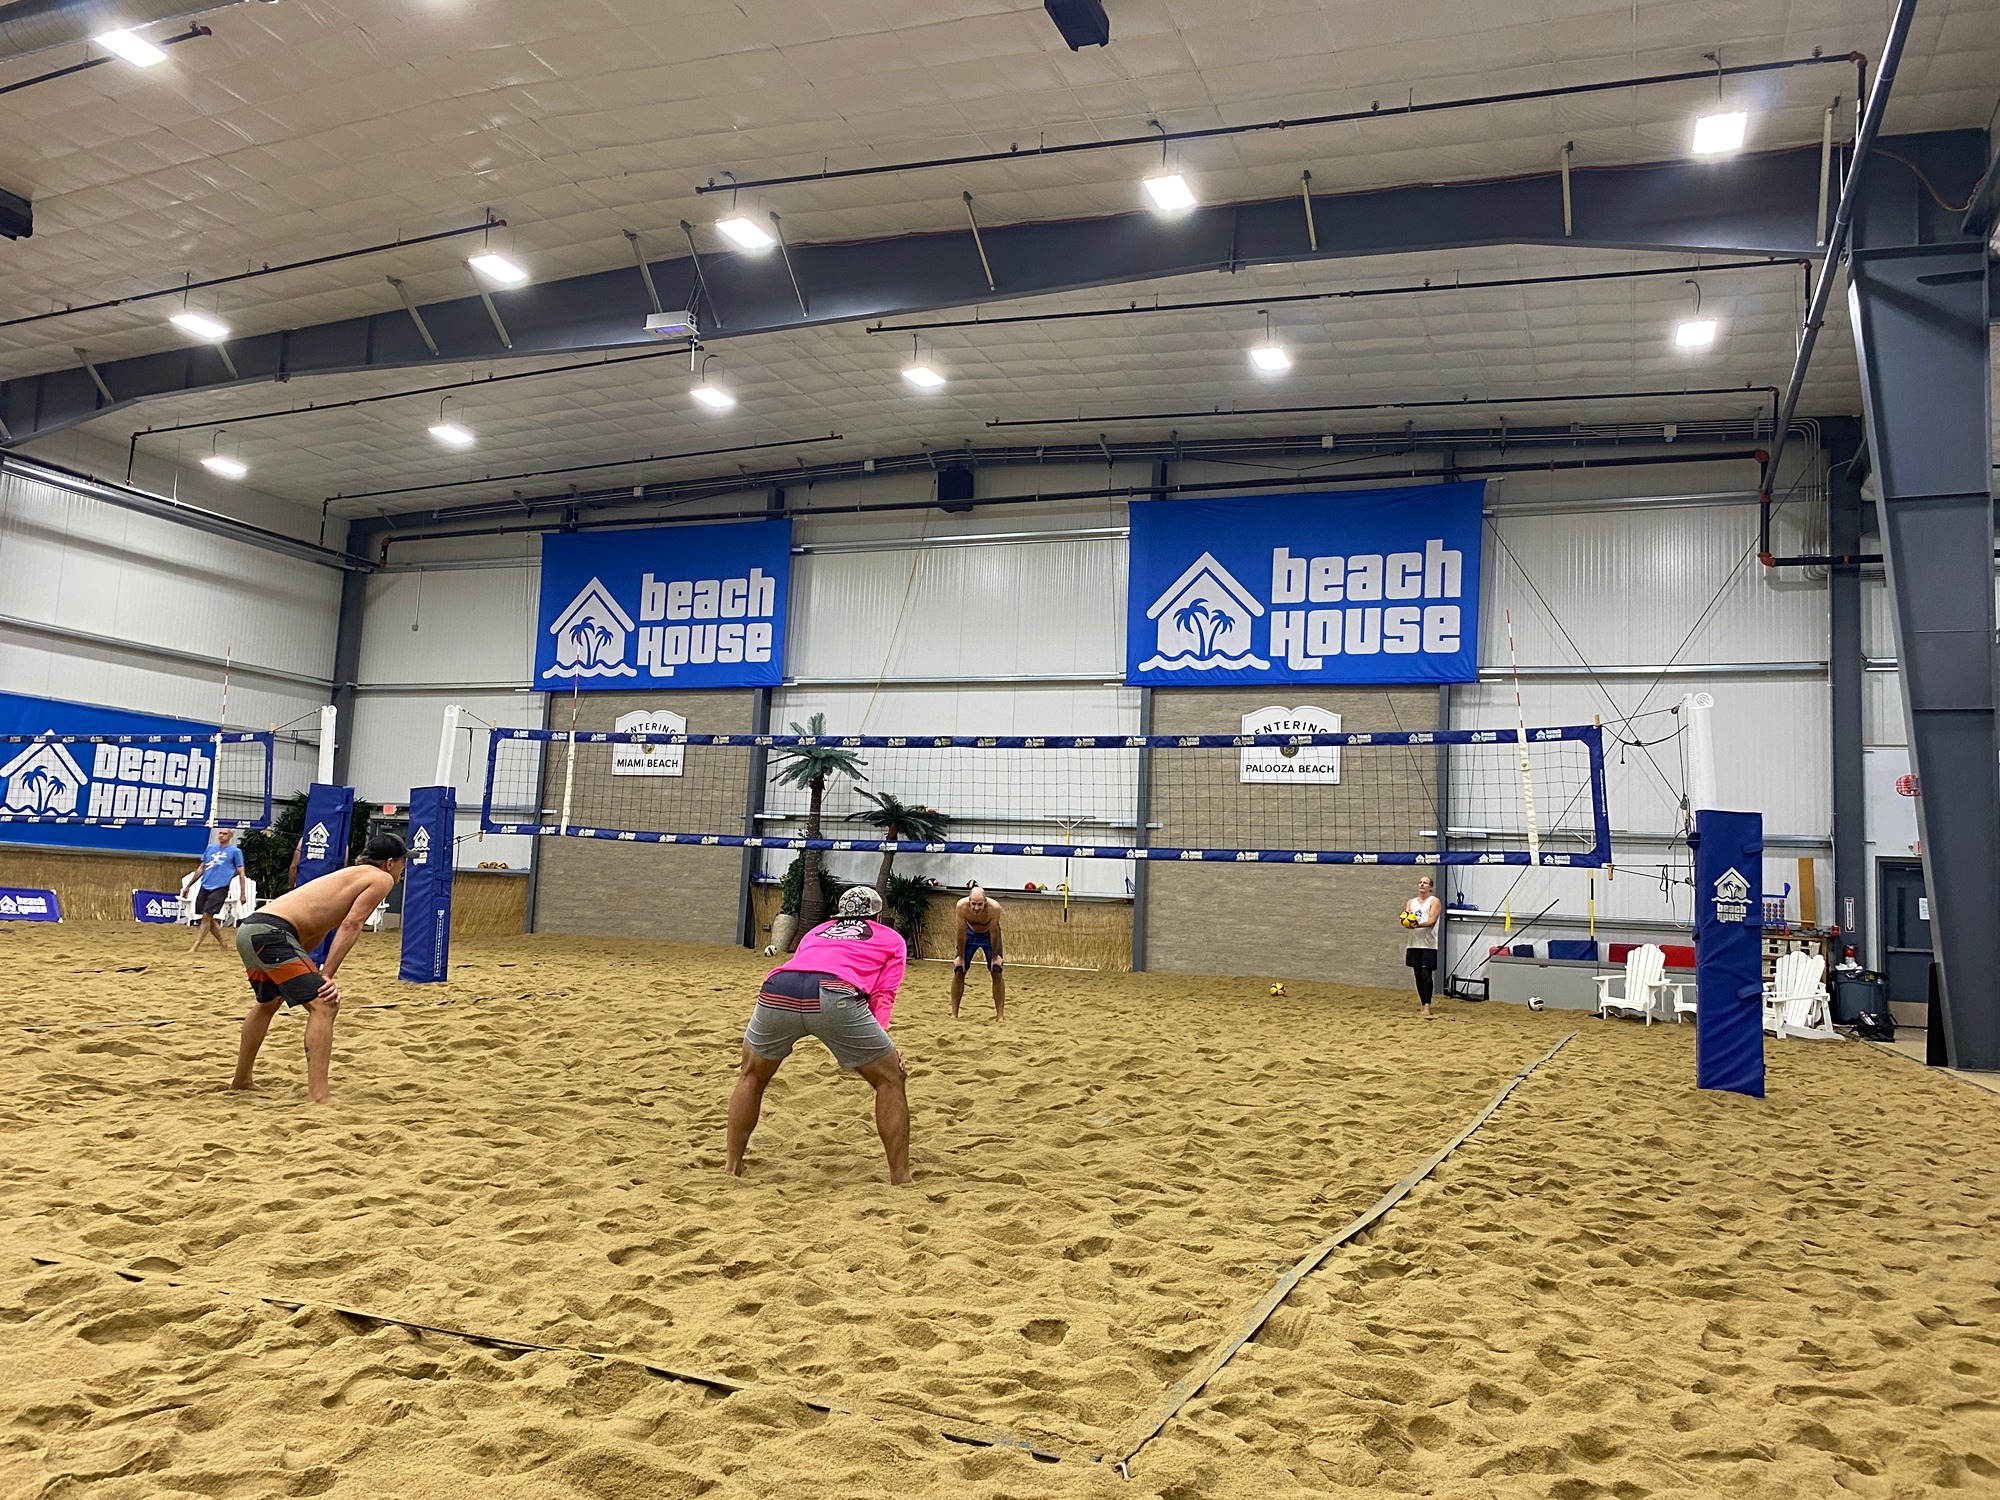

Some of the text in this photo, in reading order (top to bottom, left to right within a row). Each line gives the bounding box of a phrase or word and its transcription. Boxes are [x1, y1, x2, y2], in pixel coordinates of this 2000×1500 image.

[1270, 539, 1463, 605] beach
[640, 567, 775, 621] beach
[93, 743, 212, 790] beach
[616, 758, 679, 768] MIAMI BEACH
[1245, 764, 1335, 773] PALOOZA BEACH
[1716, 902, 1747, 914] beach
